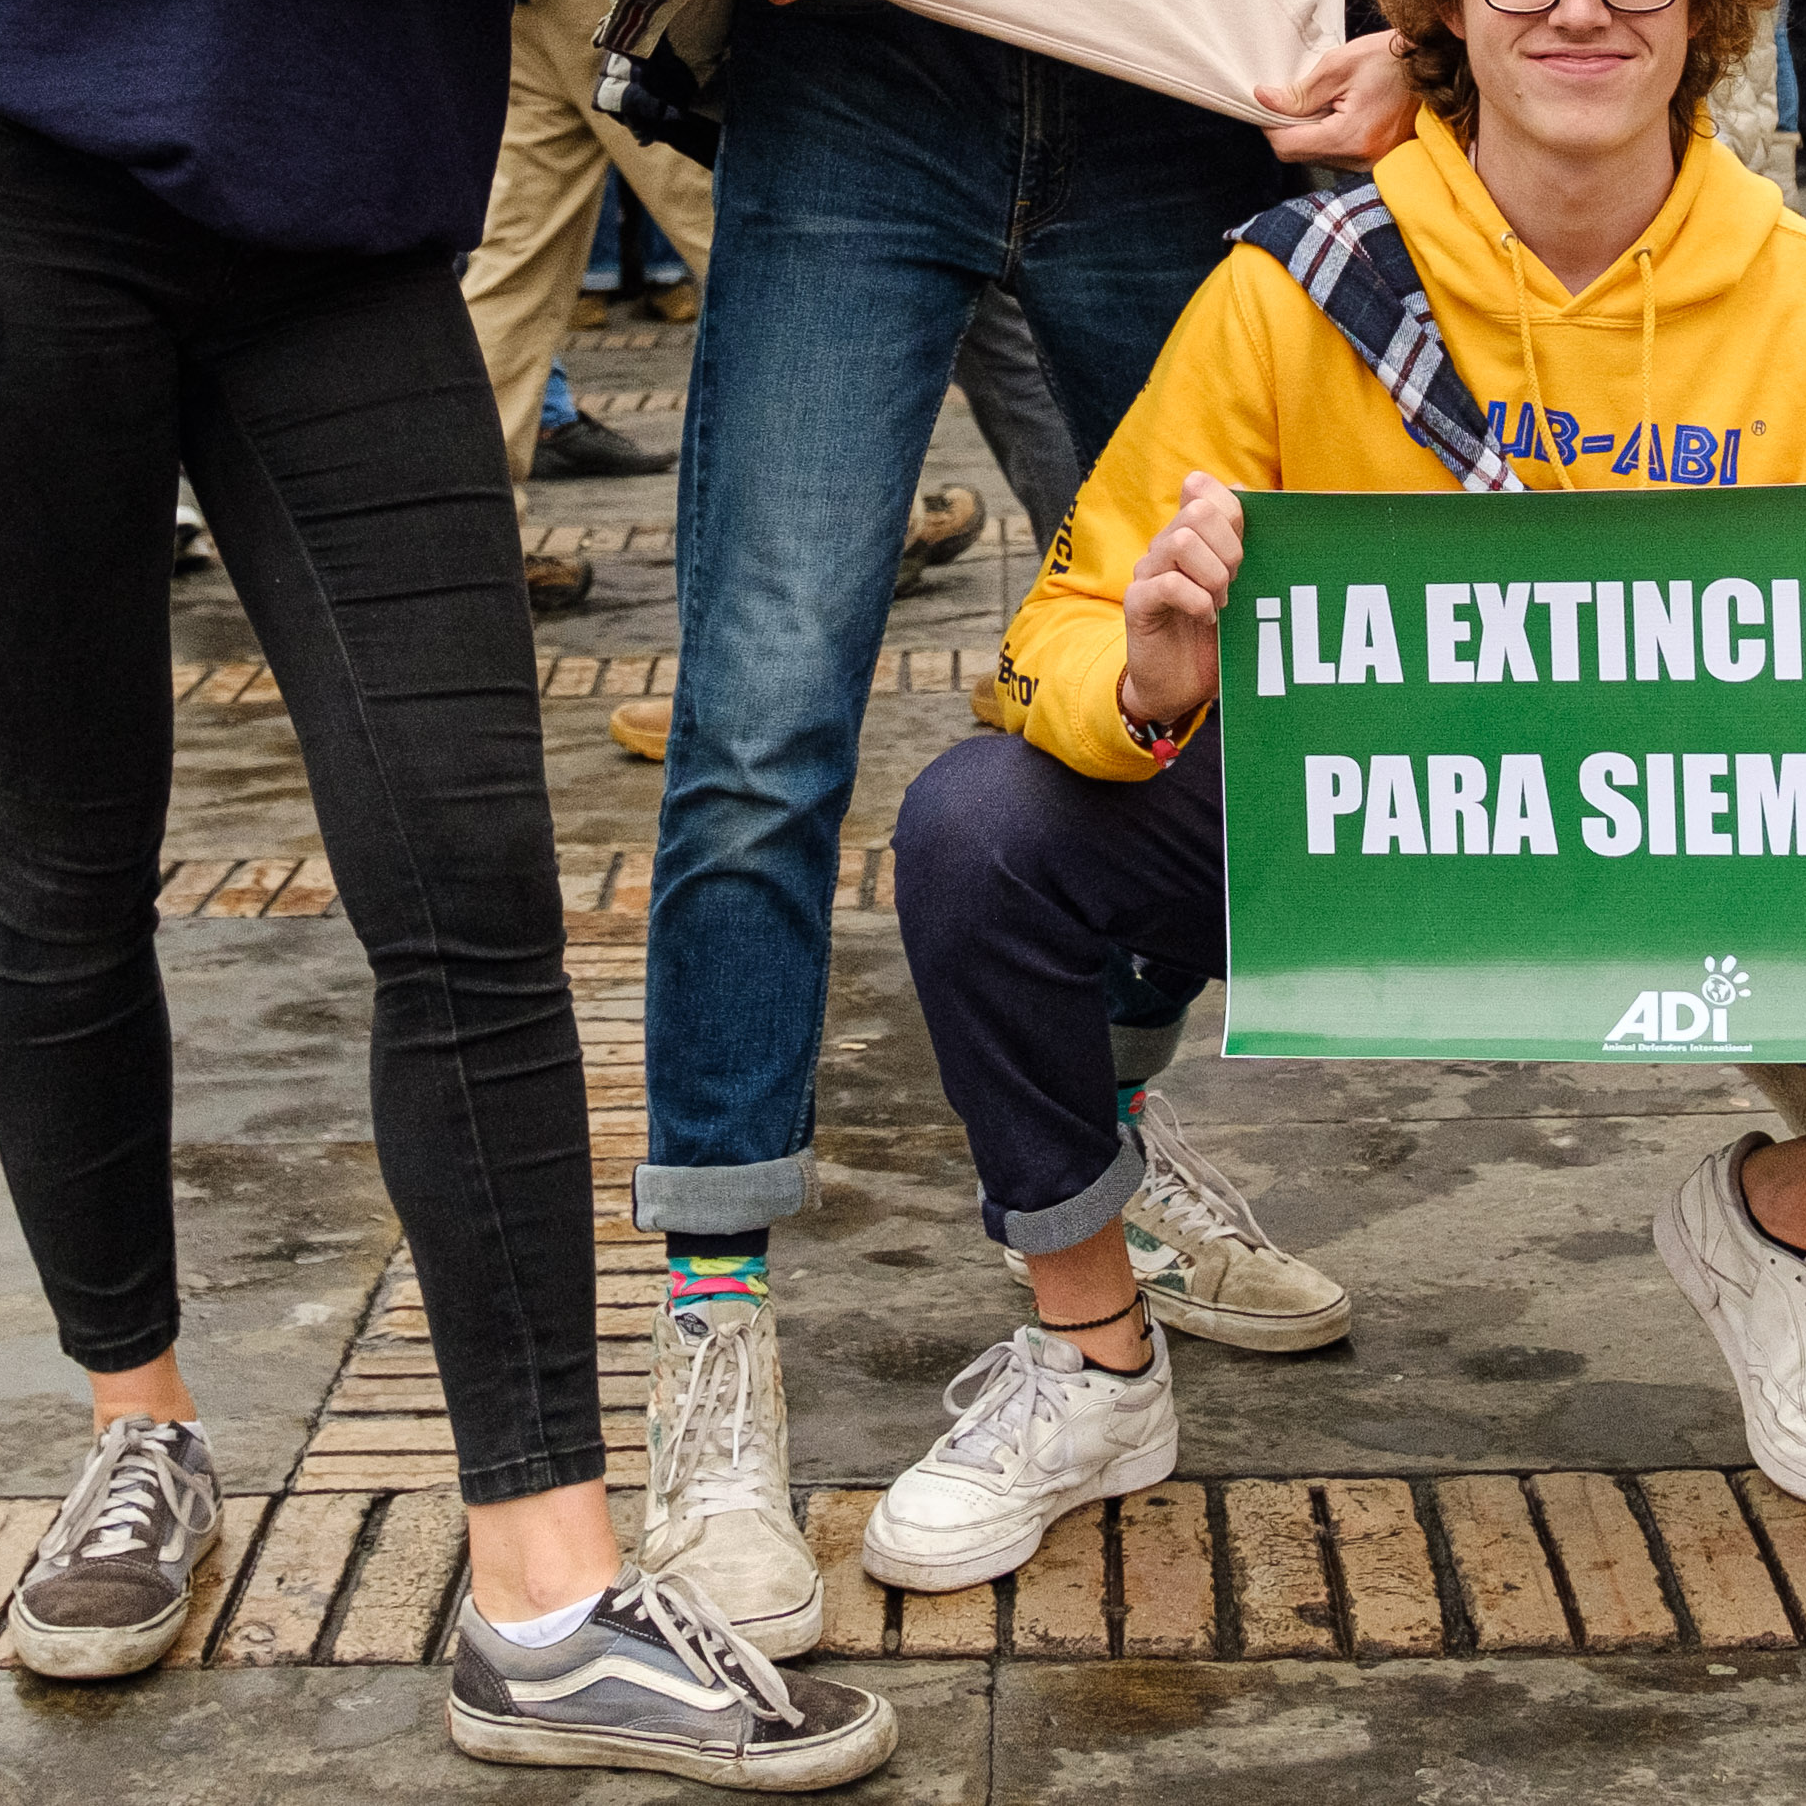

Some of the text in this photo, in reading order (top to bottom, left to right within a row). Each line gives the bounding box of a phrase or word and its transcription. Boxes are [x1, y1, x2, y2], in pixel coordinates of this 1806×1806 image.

[1256, 582, 1404, 697] ¡LA
[1304, 753, 1560, 857] PARA
[1601, 1043, 1753, 1053] Animal Defenders International
